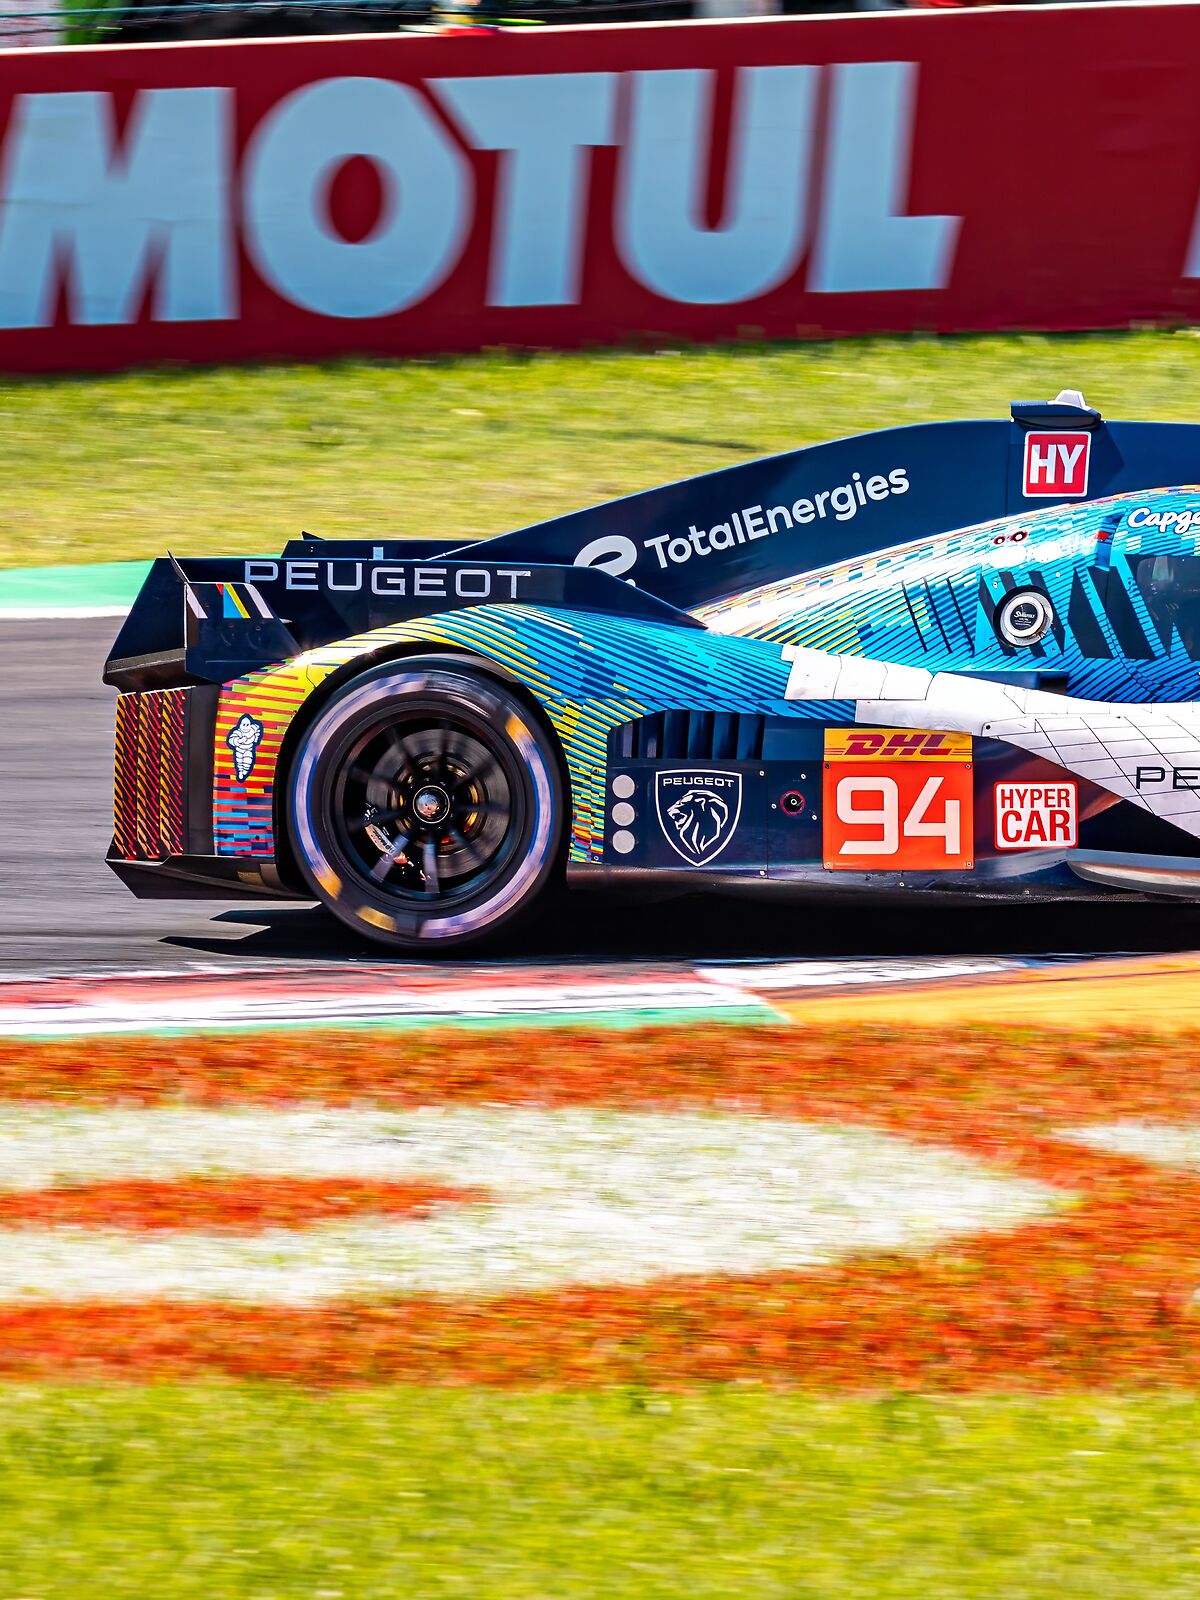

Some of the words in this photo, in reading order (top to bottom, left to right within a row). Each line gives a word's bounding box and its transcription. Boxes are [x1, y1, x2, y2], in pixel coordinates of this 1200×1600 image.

[0, 61, 963, 328] MOTUL
[1029, 444, 1085, 484] HY
[644, 467, 911, 569] TotalEnergies
[244, 560, 531, 599] PEUGEOT
[844, 734, 952, 755] DHL
[663, 777, 734, 789] PEUGEOT
[1000, 788, 1071, 810] HYPER
[836, 776, 962, 856] 94
[1001, 810, 1072, 843] CAR
